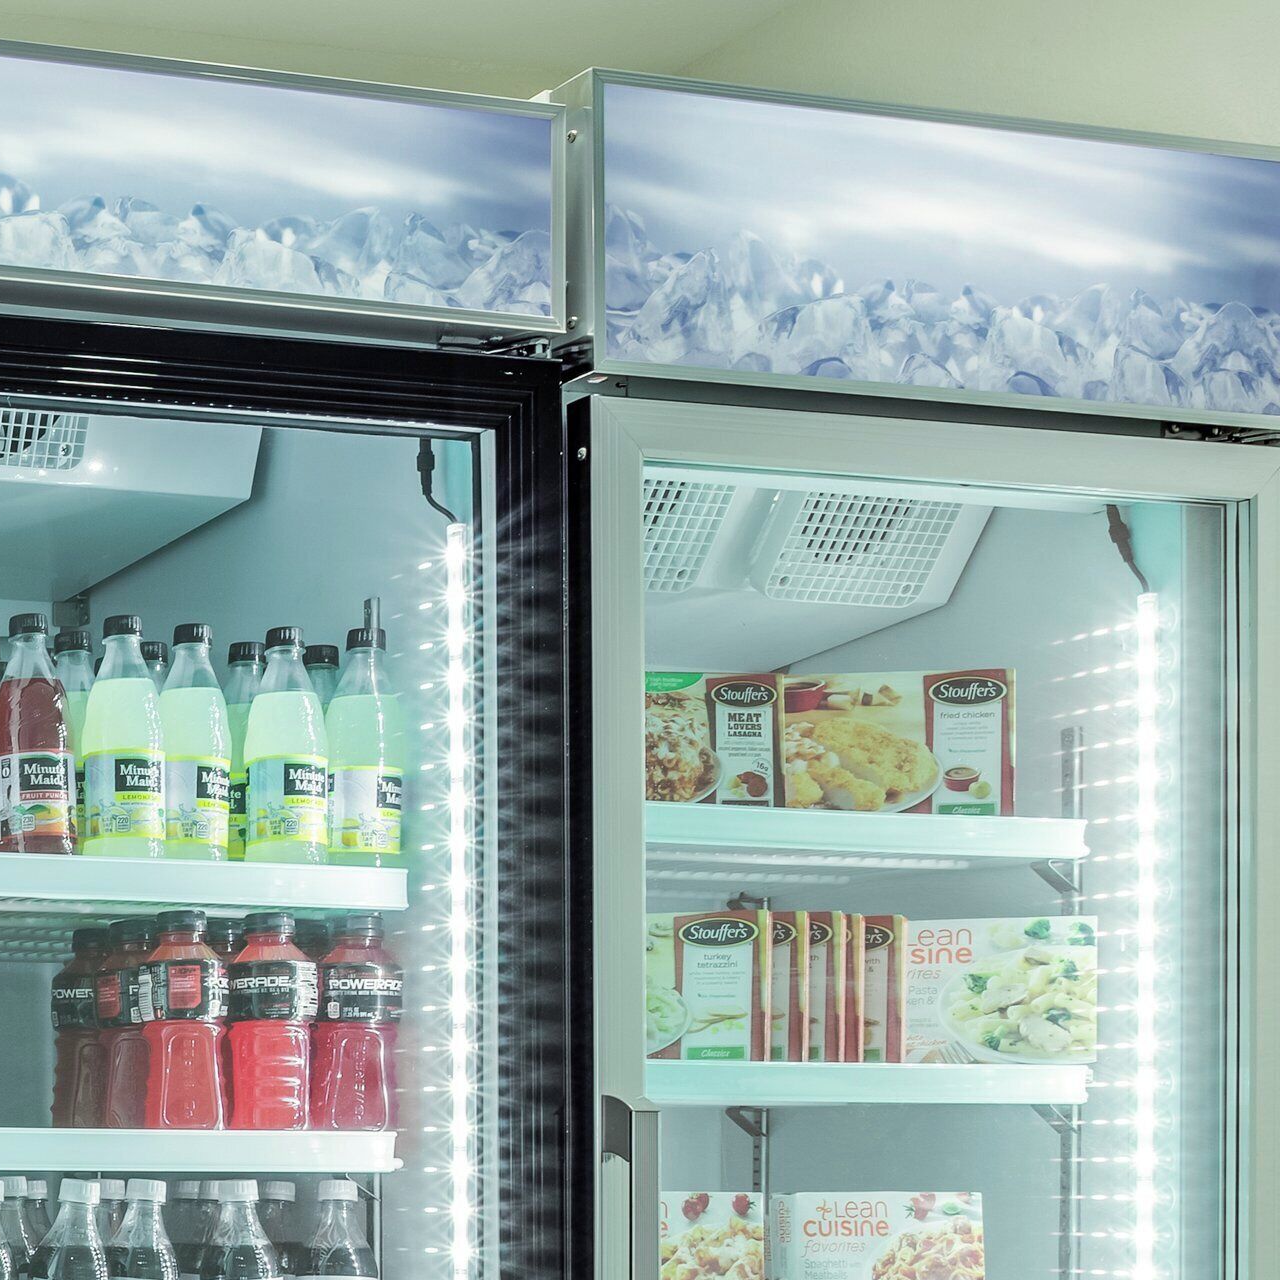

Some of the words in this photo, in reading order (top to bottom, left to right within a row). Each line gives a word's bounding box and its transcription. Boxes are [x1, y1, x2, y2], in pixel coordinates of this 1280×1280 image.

[719, 686, 769, 703] Stouffer's
[938, 682, 996, 700] Stouffer's
[727, 712, 762, 723] MEAT
[940, 711, 961, 719] fried
[964, 710, 995, 719] chicken
[24, 763, 65, 776] Minute
[30, 774, 61, 786] Maid
[687, 923, 748, 942] Stouffer's
[697, 959, 738, 969] tetrazzini
[704, 953, 732, 963] turkey
[329, 979, 402, 991] POWERADE
[832, 1200, 888, 1218] Lean
[803, 1219, 889, 1237] cuisine
[802, 1239, 866, 1257] favorites
[804, 1259, 847, 1272] Spaghetti
[804, 1270, 847, 1280] Meatballs
